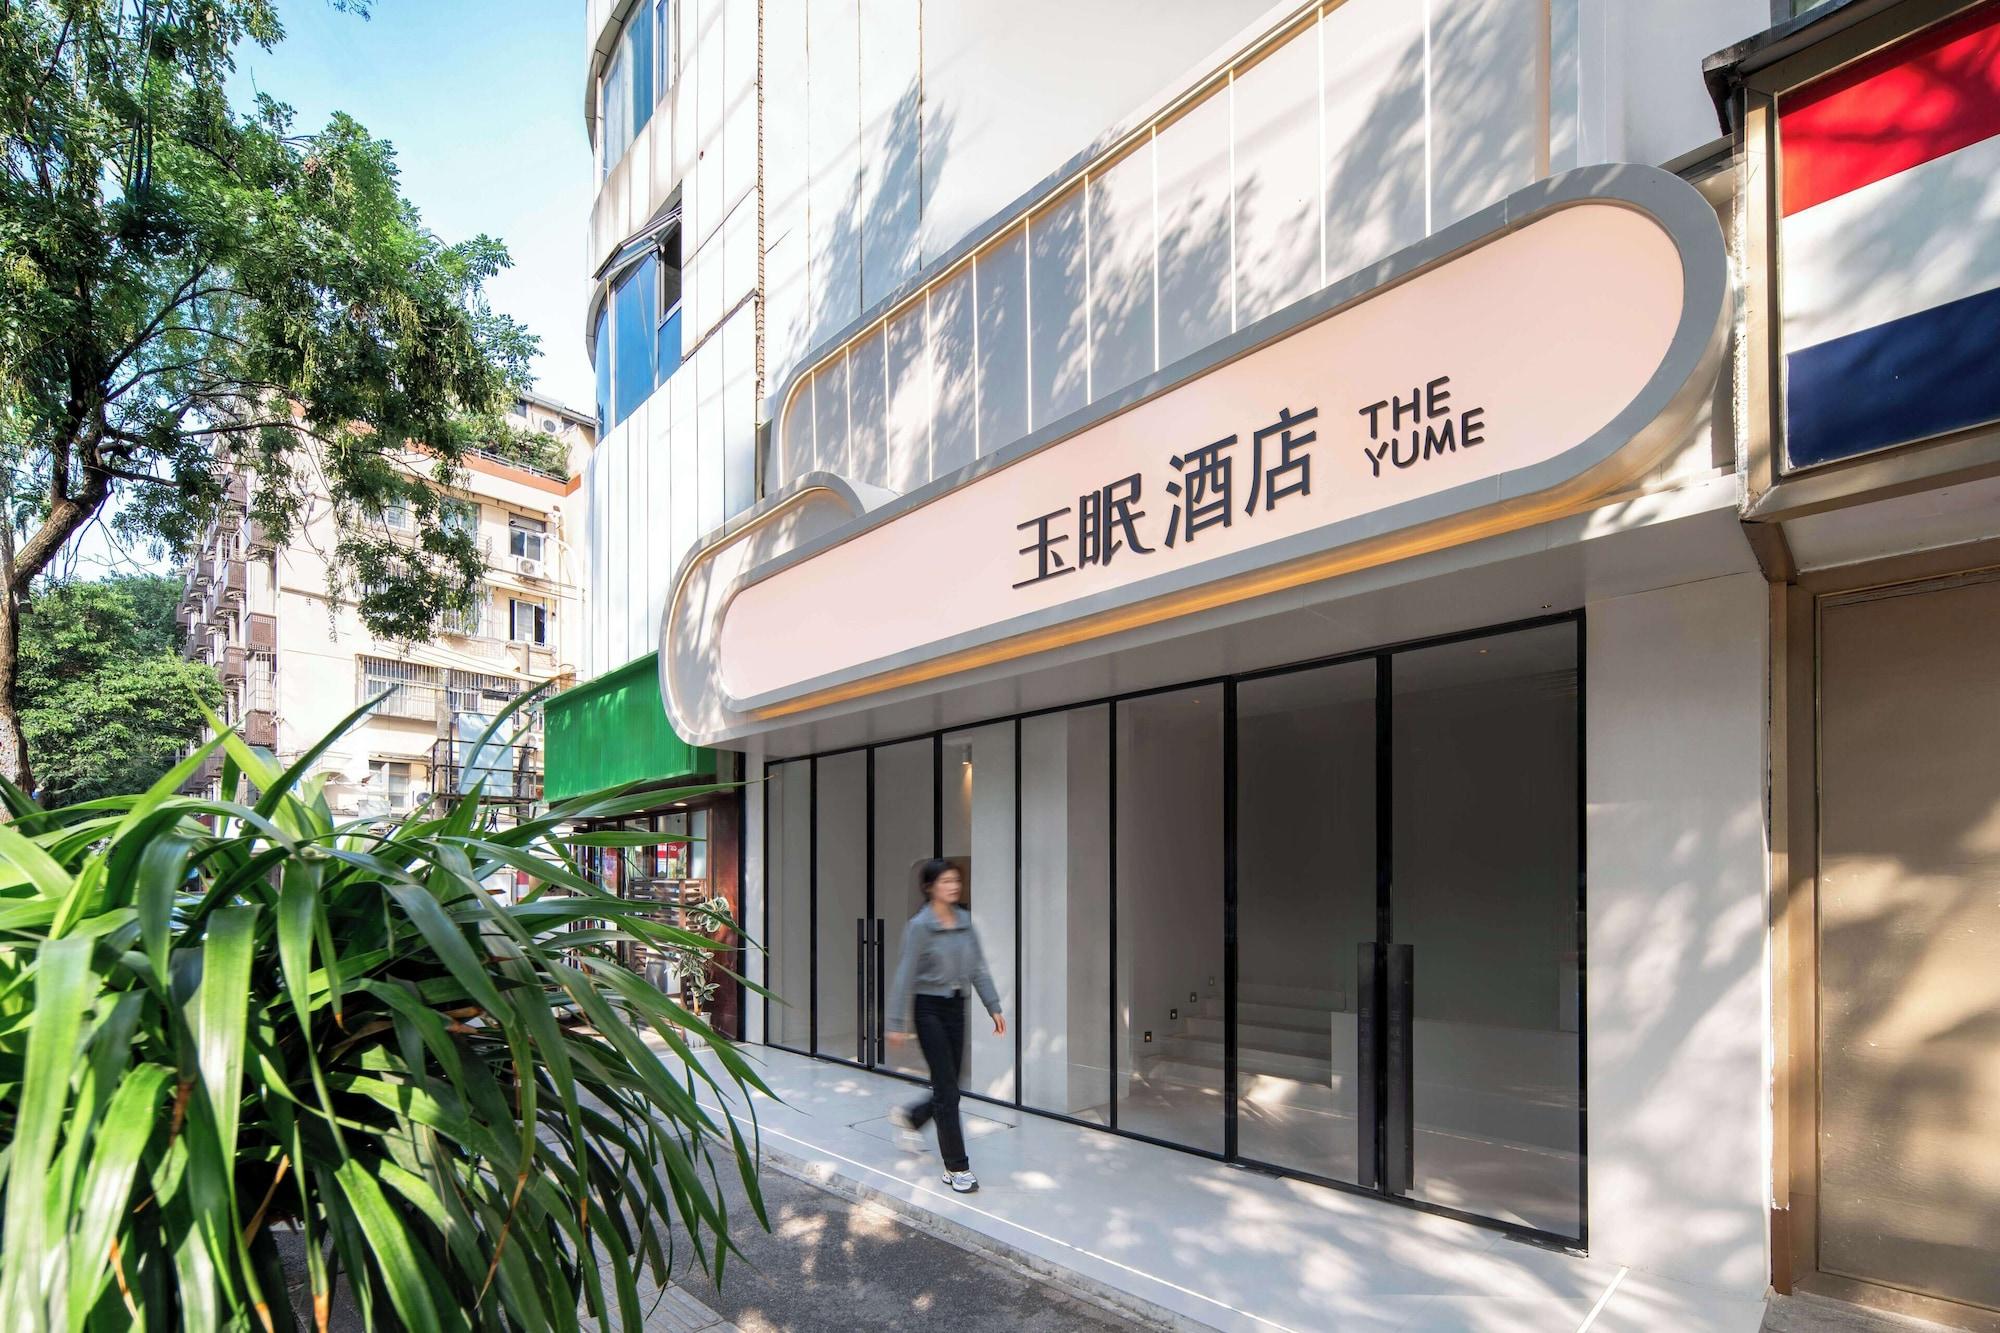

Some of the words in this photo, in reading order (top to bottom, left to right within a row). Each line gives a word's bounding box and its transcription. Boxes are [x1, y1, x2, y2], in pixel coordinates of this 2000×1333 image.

[1358, 375, 1451, 440] THE
[1363, 407, 1486, 478] YUME
[1012, 406, 1319, 589] 玉眠酒店
